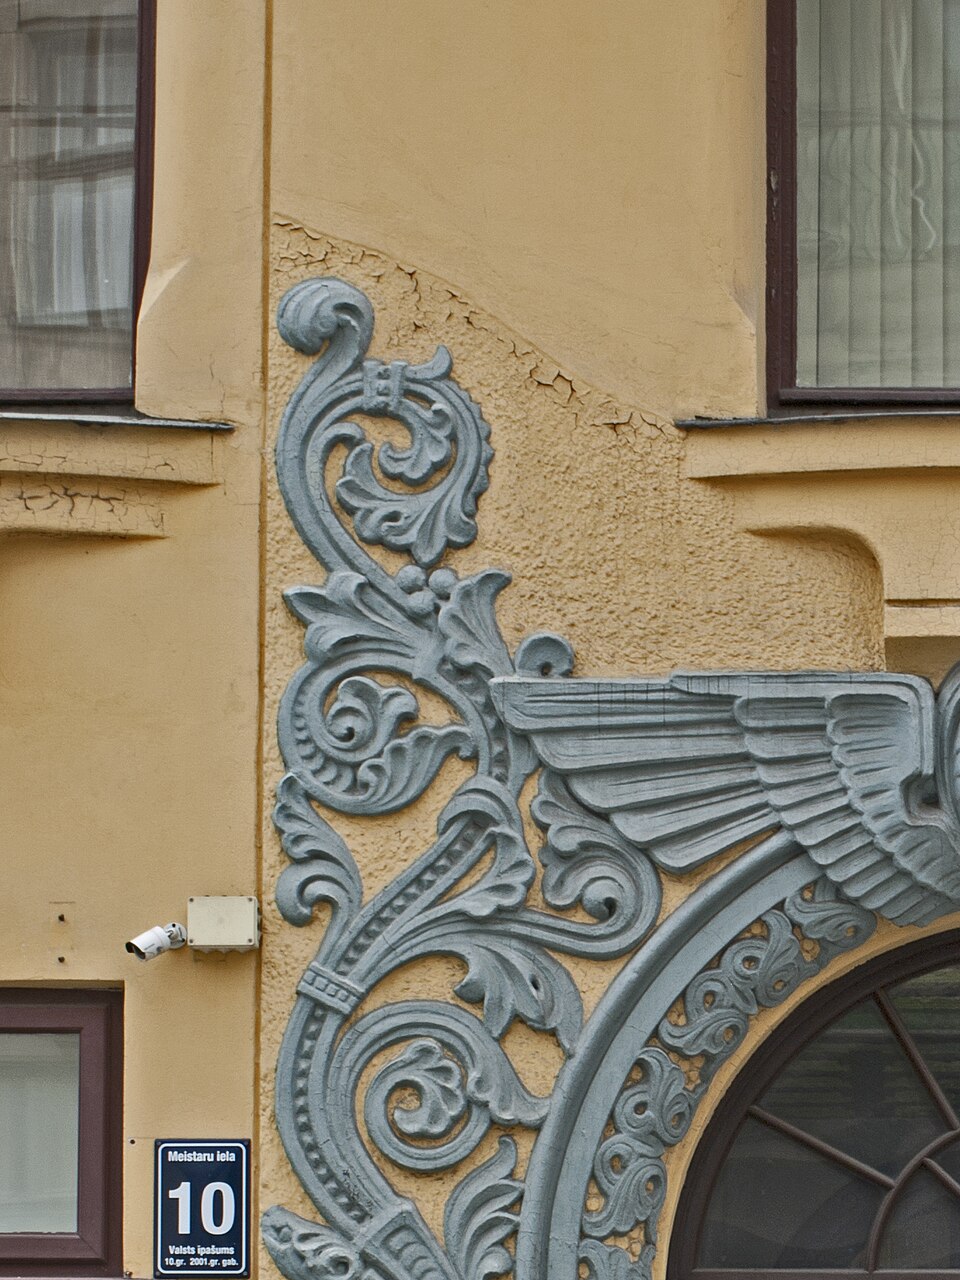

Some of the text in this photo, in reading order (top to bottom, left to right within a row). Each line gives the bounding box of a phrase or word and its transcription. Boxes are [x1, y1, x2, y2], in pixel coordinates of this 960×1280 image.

[168, 1151, 236, 1162] Meistaru iela
[168, 1181, 235, 1235] 10
[169, 1245, 195, 1255] Valsts
[189, 1257, 220, 1267] 2001.gr.
[222, 1257, 239, 1267] gab.
